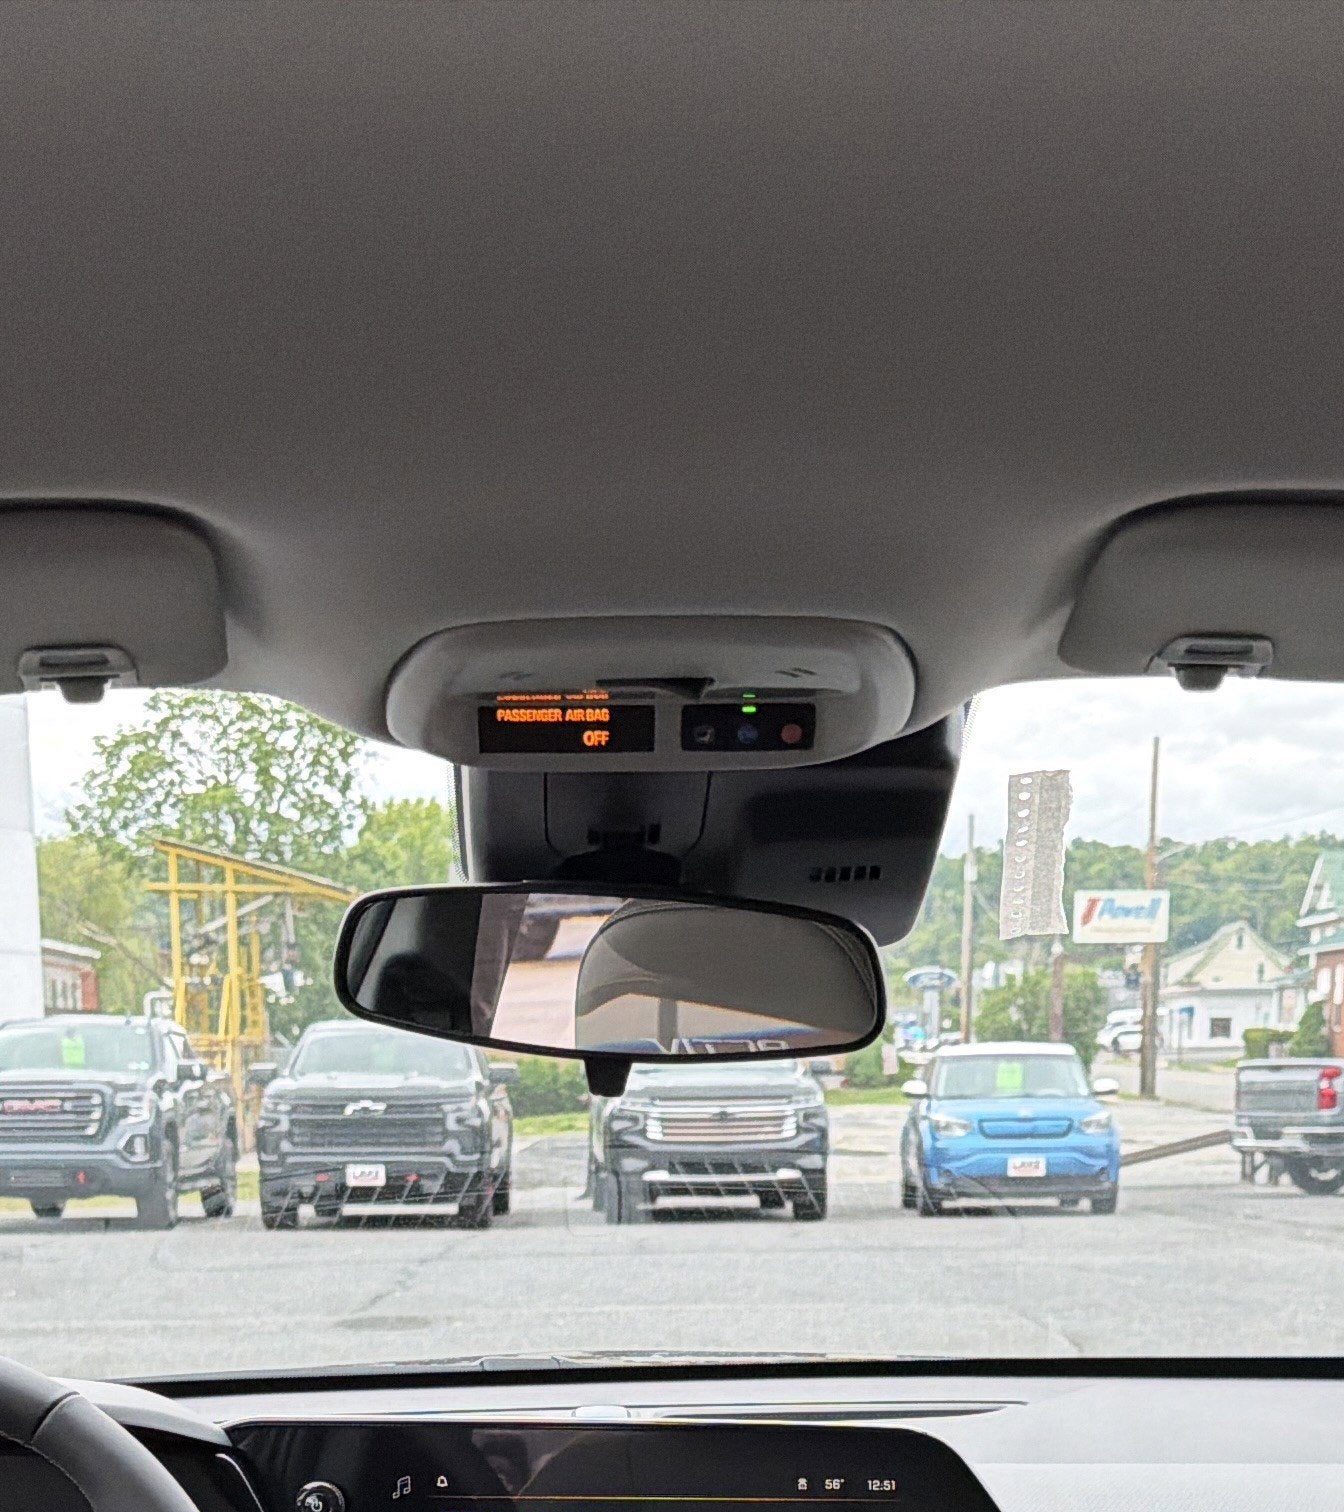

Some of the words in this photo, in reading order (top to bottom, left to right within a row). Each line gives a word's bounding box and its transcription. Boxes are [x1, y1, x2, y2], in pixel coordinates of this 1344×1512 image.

[496, 708, 563, 722] PASSENGER
[565, 708, 585, 722] AIR
[586, 708, 610, 722] BAG
[582, 730, 610, 747] OFF
[824, 1478, 845, 1490] 56°
[867, 1480, 896, 1491] 12:51
